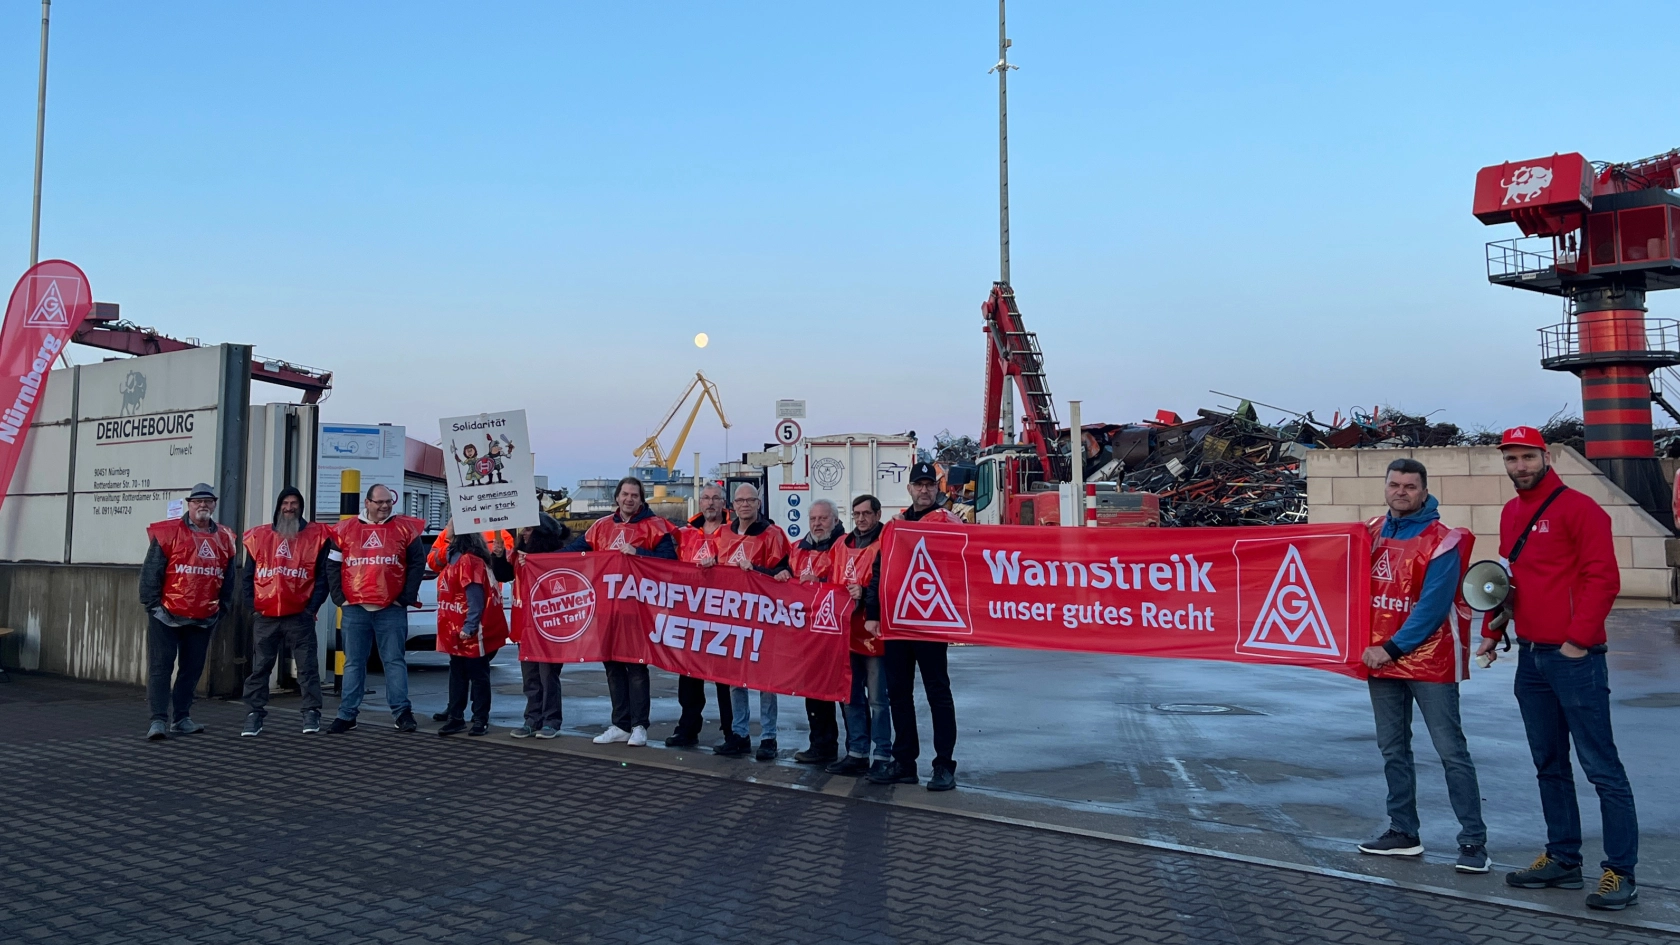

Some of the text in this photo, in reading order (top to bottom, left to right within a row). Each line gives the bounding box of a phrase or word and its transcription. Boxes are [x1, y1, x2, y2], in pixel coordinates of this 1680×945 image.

[0, 333, 62, 445] Nürnberg
[96, 413, 194, 440] DERICHEBOURG
[452, 418, 506, 432] Solidarität
[783, 425, 793, 440] 5
[169, 443, 193, 456] Umwelt
[94, 467, 130, 478] 90451 Nürnberg
[93, 480, 122, 489] Rotterdamer
[122, 480, 131, 489] Str.
[141, 479, 150, 488] 110
[94, 492, 171, 503] Verwaltung: Rotterdamer Str. 111
[459, 490, 518, 502] Nur gemeinsam
[93, 506, 132, 516] Tel. 0911/94472-0
[462, 504, 477, 512] sind
[982, 548, 1217, 593] Warnstreik
[531, 589, 595, 617] MehrWert
[602, 573, 806, 629] TARIFVERTRAG
[543, 610, 587, 629] mit Tarif
[988, 598, 1215, 632] unser gutes Recht
[649, 614, 764, 662] JETZT!
